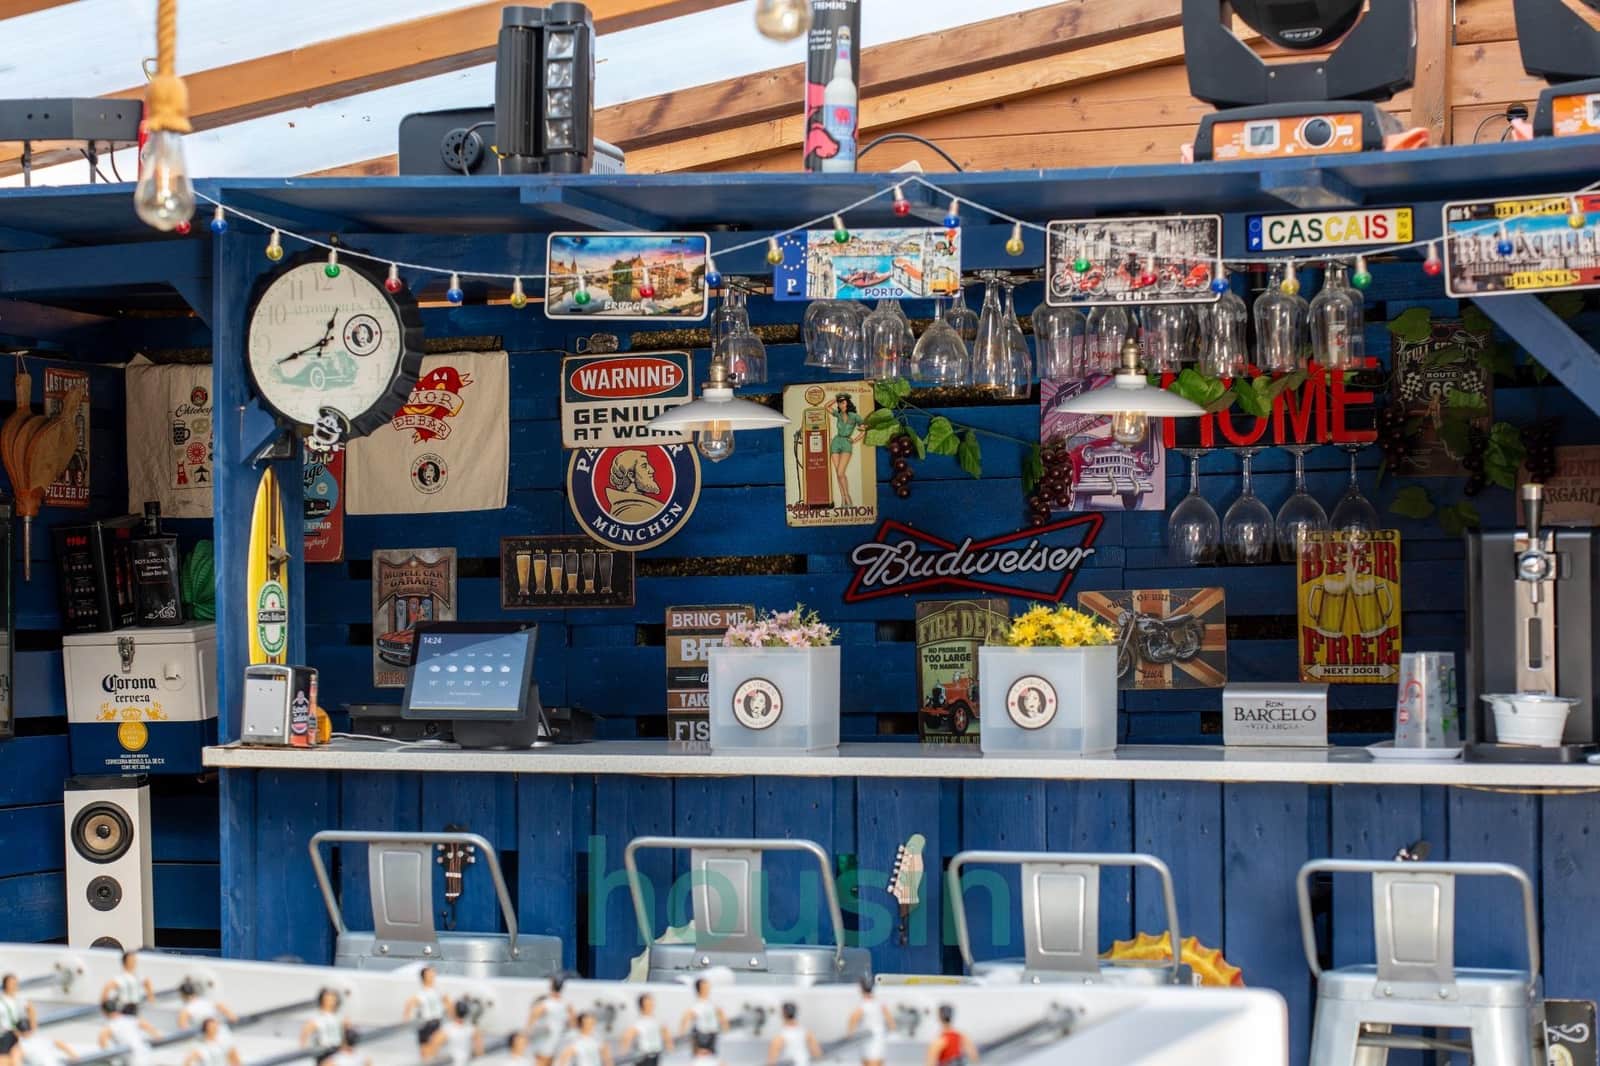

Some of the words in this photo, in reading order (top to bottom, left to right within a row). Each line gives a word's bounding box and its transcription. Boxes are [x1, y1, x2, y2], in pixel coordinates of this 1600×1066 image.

[1268, 213, 1389, 245] CASCAIS
[786, 278, 797, 292] P
[1505, 271, 1580, 287] BRUSSELS
[864, 287, 904, 297] PORTO
[1116, 291, 1150, 301] GENT
[579, 365, 675, 391] WARNING
[1161, 358, 1379, 448] HOME
[574, 427, 602, 441] AT
[792, 508, 831, 519] SERVICE
[834, 505, 874, 518] STATION
[592, 501, 683, 542] MÜNCHEN
[851, 537, 1096, 585] Budweiser
[1301, 541, 1398, 584] BEER
[383, 569, 419, 579] MUSCLE
[423, 569, 443, 578] CAR
[390, 577, 438, 588] GARAGE
[672, 612, 721, 627] BRING
[725, 612, 746, 625] ME
[919, 610, 959, 646] FIRE
[938, 646, 966, 654] PROBLEM
[1303, 624, 1400, 665] FREE
[923, 654, 941, 663] TOO
[943, 653, 972, 662] LARGE
[1323, 666, 1350, 676] NEXT
[1352, 666, 1381, 675] DOOR
[102, 674, 157, 695] Corona
[115, 694, 151, 702] cerveza
[679, 693, 710, 708] TAK
[1233, 705, 1317, 723] BARCELÓ
[674, 720, 710, 742] FIS
